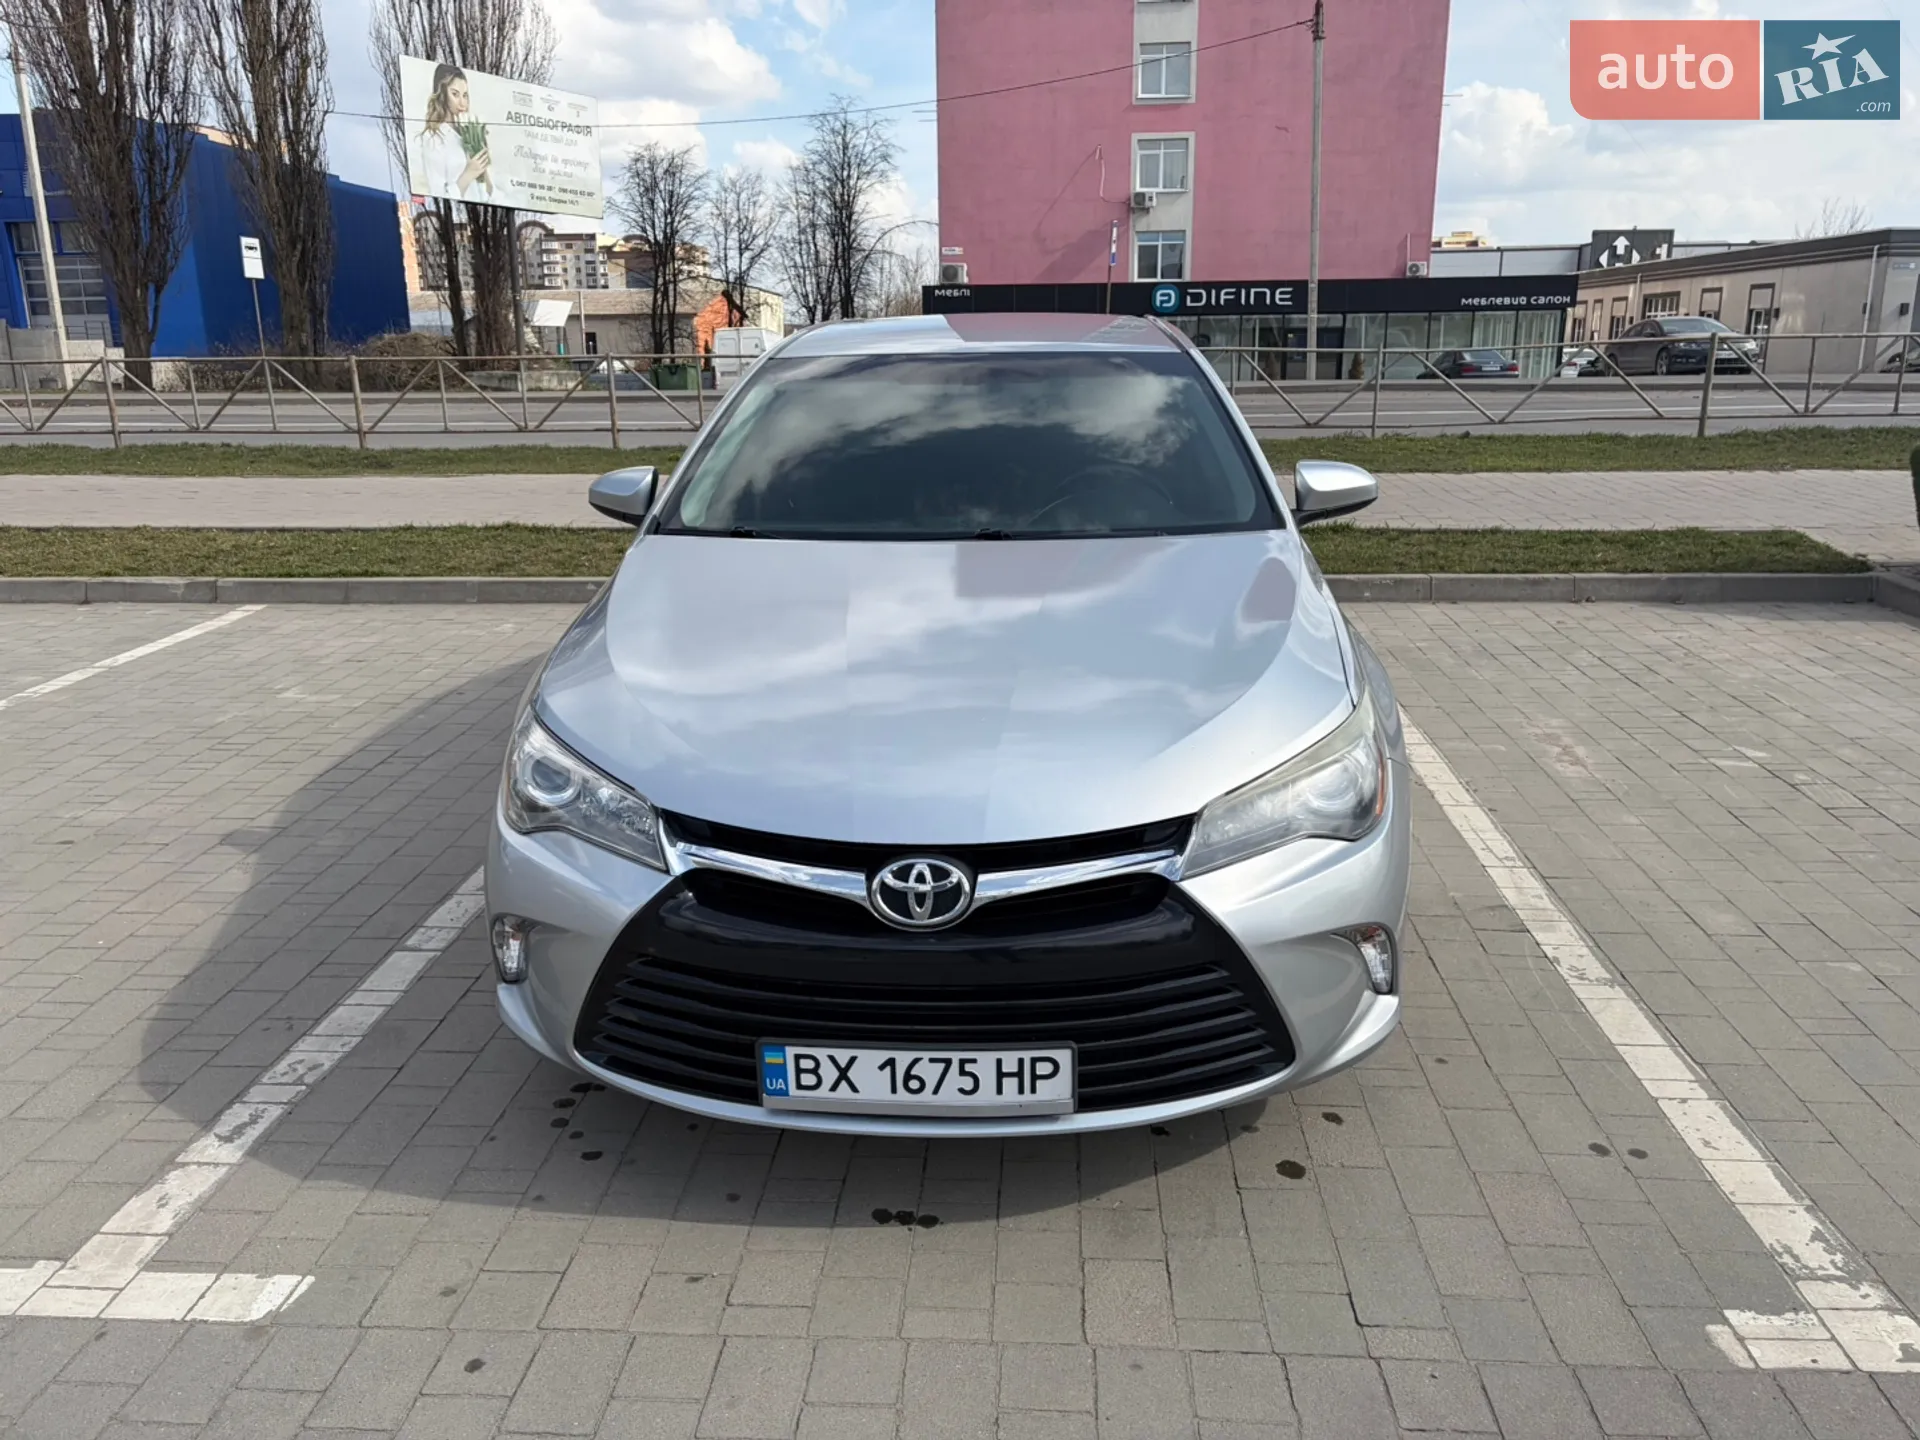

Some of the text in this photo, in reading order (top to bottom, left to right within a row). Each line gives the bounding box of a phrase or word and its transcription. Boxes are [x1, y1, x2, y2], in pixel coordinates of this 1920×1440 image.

[505, 110, 593, 137] АВТОБІОГРАФІЯ
[1186, 287, 1294, 307] DIFINE
[765, 1077, 787, 1091] UA
[793, 1053, 1061, 1096] BX 1675 HP
